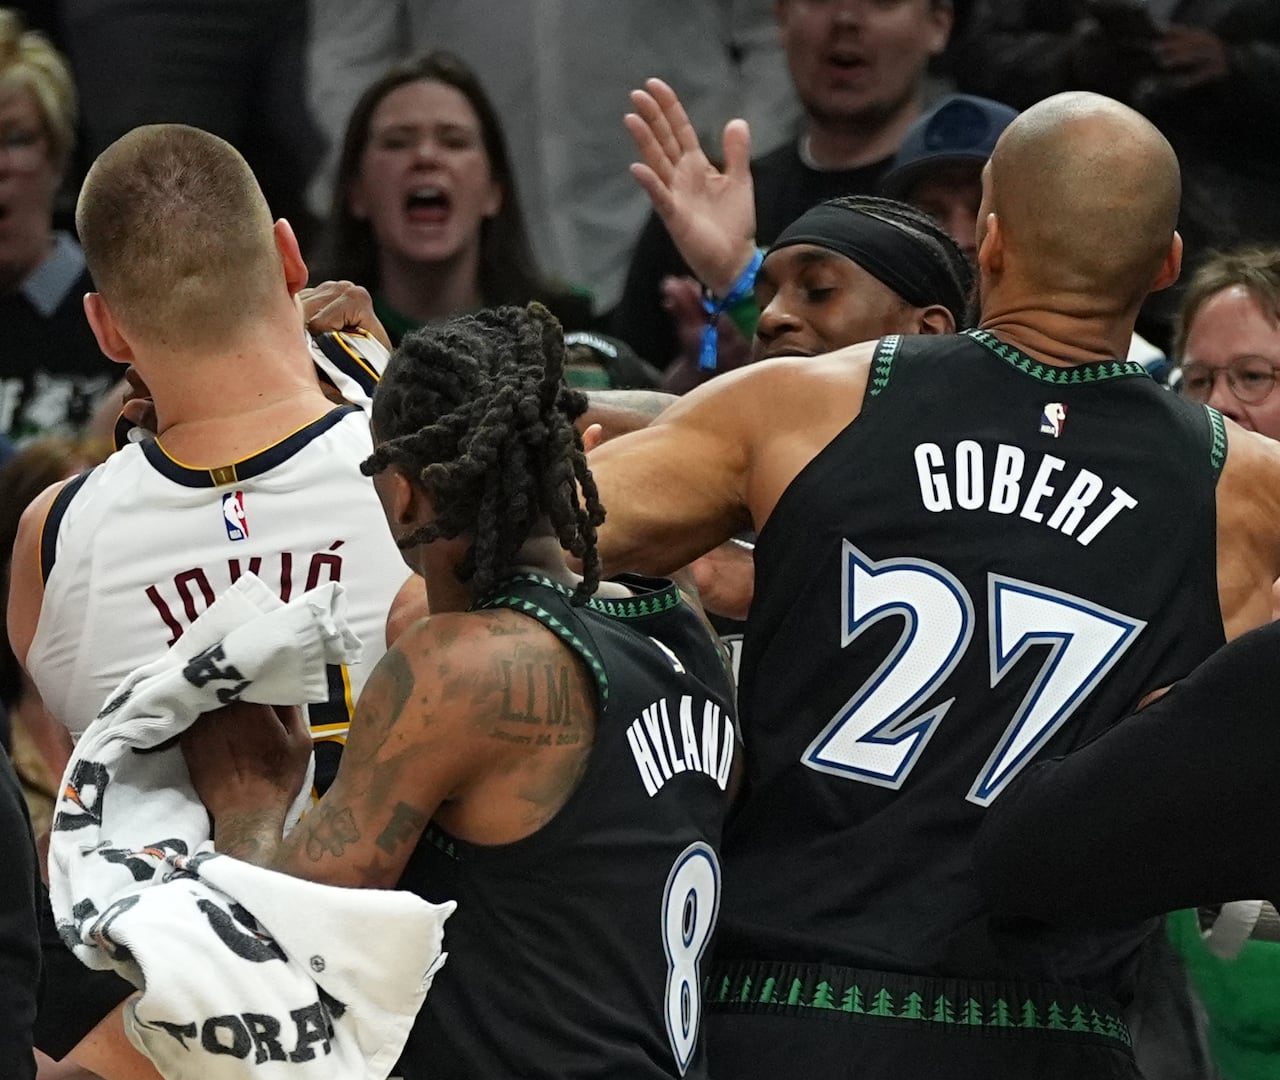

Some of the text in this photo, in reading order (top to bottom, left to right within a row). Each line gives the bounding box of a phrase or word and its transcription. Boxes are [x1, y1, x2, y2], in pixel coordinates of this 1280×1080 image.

[914, 440, 1138, 546] GOBERT
[626, 695, 735, 798] HYLAND
[801, 538, 1148, 808] 27
[661, 840, 720, 1078] 8
